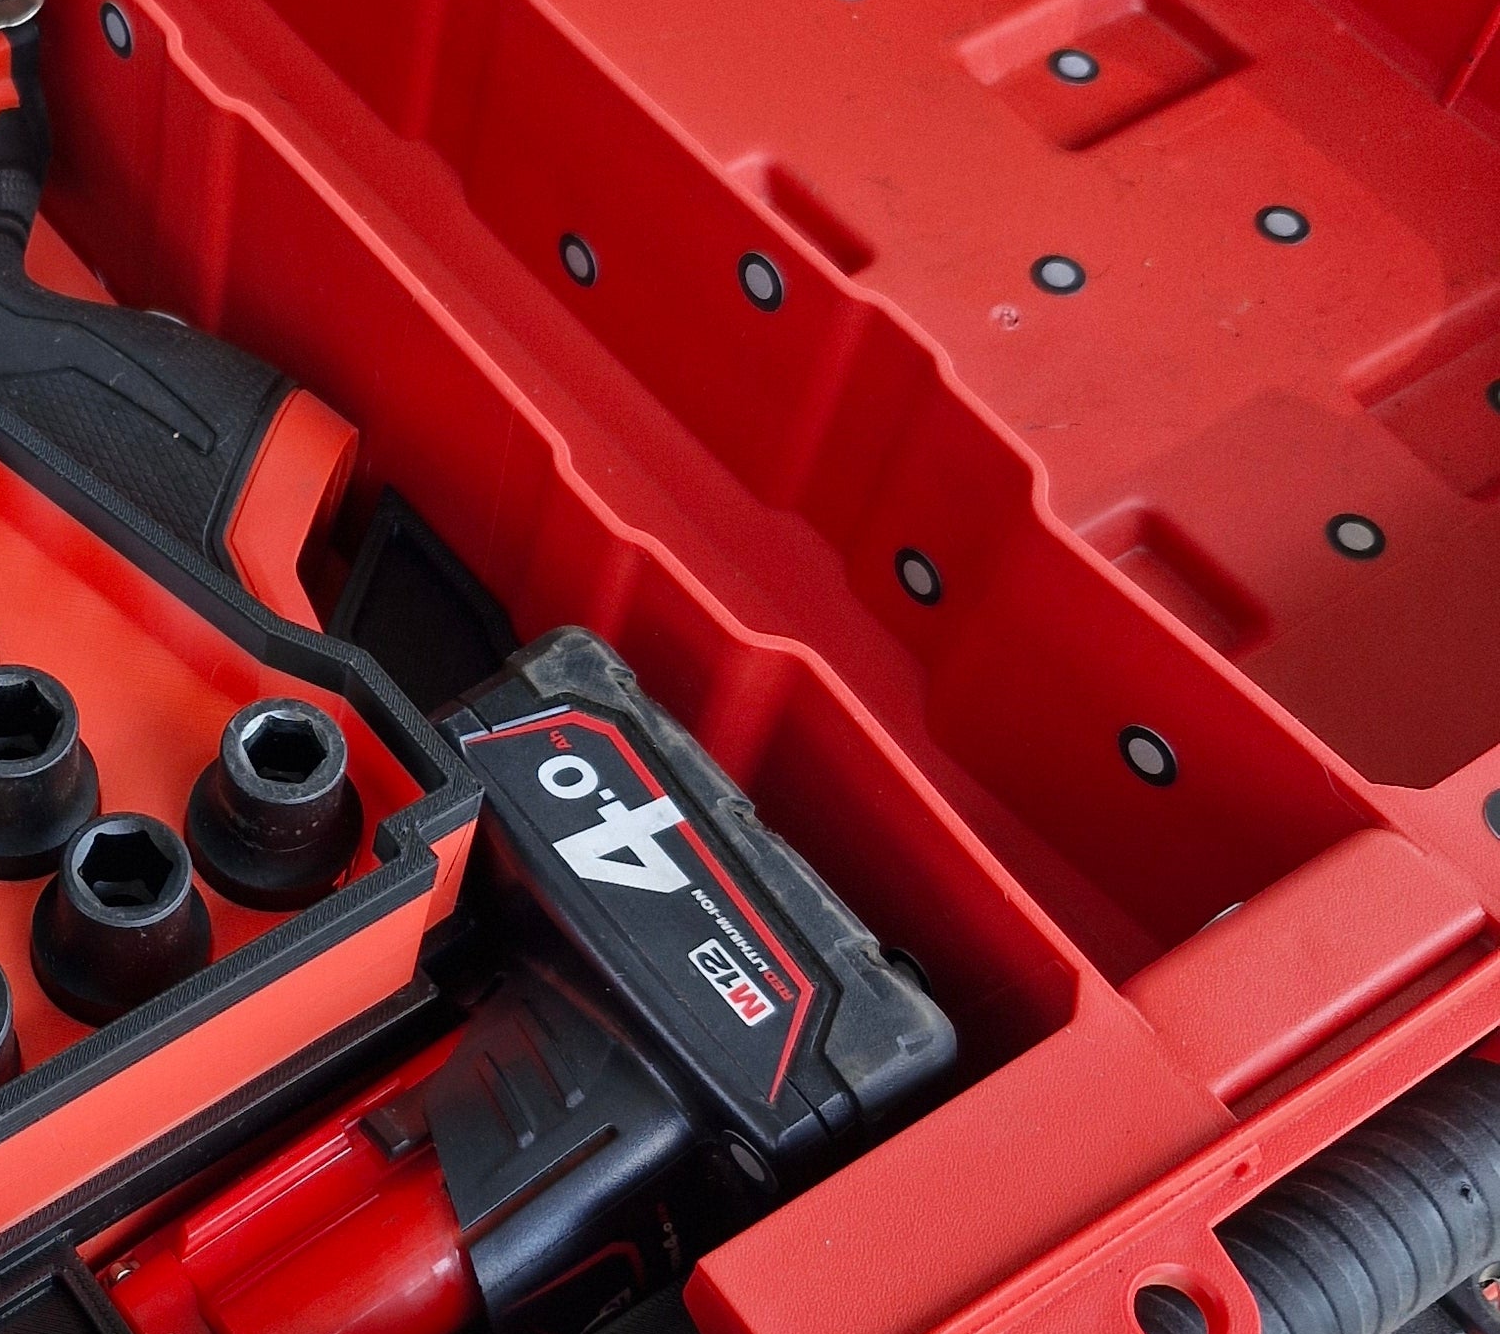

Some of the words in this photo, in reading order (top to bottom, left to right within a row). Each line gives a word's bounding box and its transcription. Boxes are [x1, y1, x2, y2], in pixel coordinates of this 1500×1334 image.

[550, 729, 573, 750] Ah
[537, 754, 692, 894] 4.0
[694, 944, 769, 1021] M12
